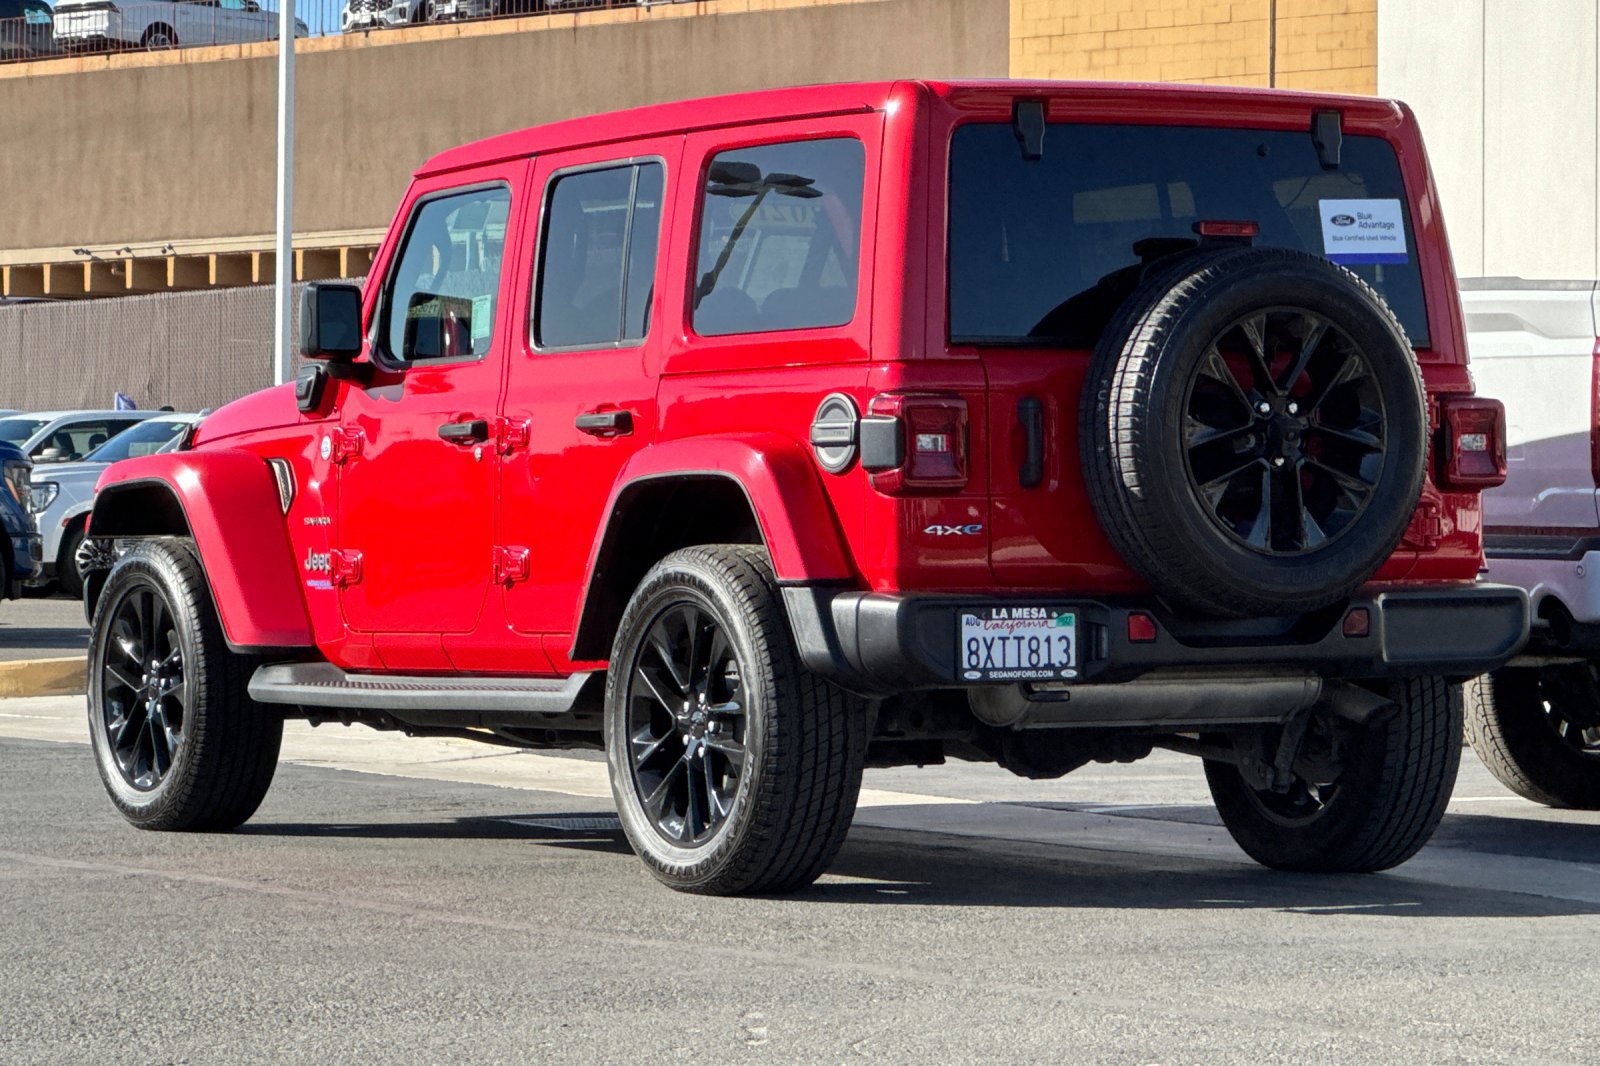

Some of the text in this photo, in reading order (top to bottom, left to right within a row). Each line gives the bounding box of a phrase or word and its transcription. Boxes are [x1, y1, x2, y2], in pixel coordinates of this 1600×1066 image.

[1357, 211, 1372, 220] Blue
[1358, 221, 1395, 231] Advantage
[304, 547, 331, 575] Jeep
[992, 607, 1047, 619] LA MESA
[983, 620, 1056, 635] California
[967, 635, 1071, 668] 8XTT813
[989, 670, 1054, 679] SEDANOFORD.COM
